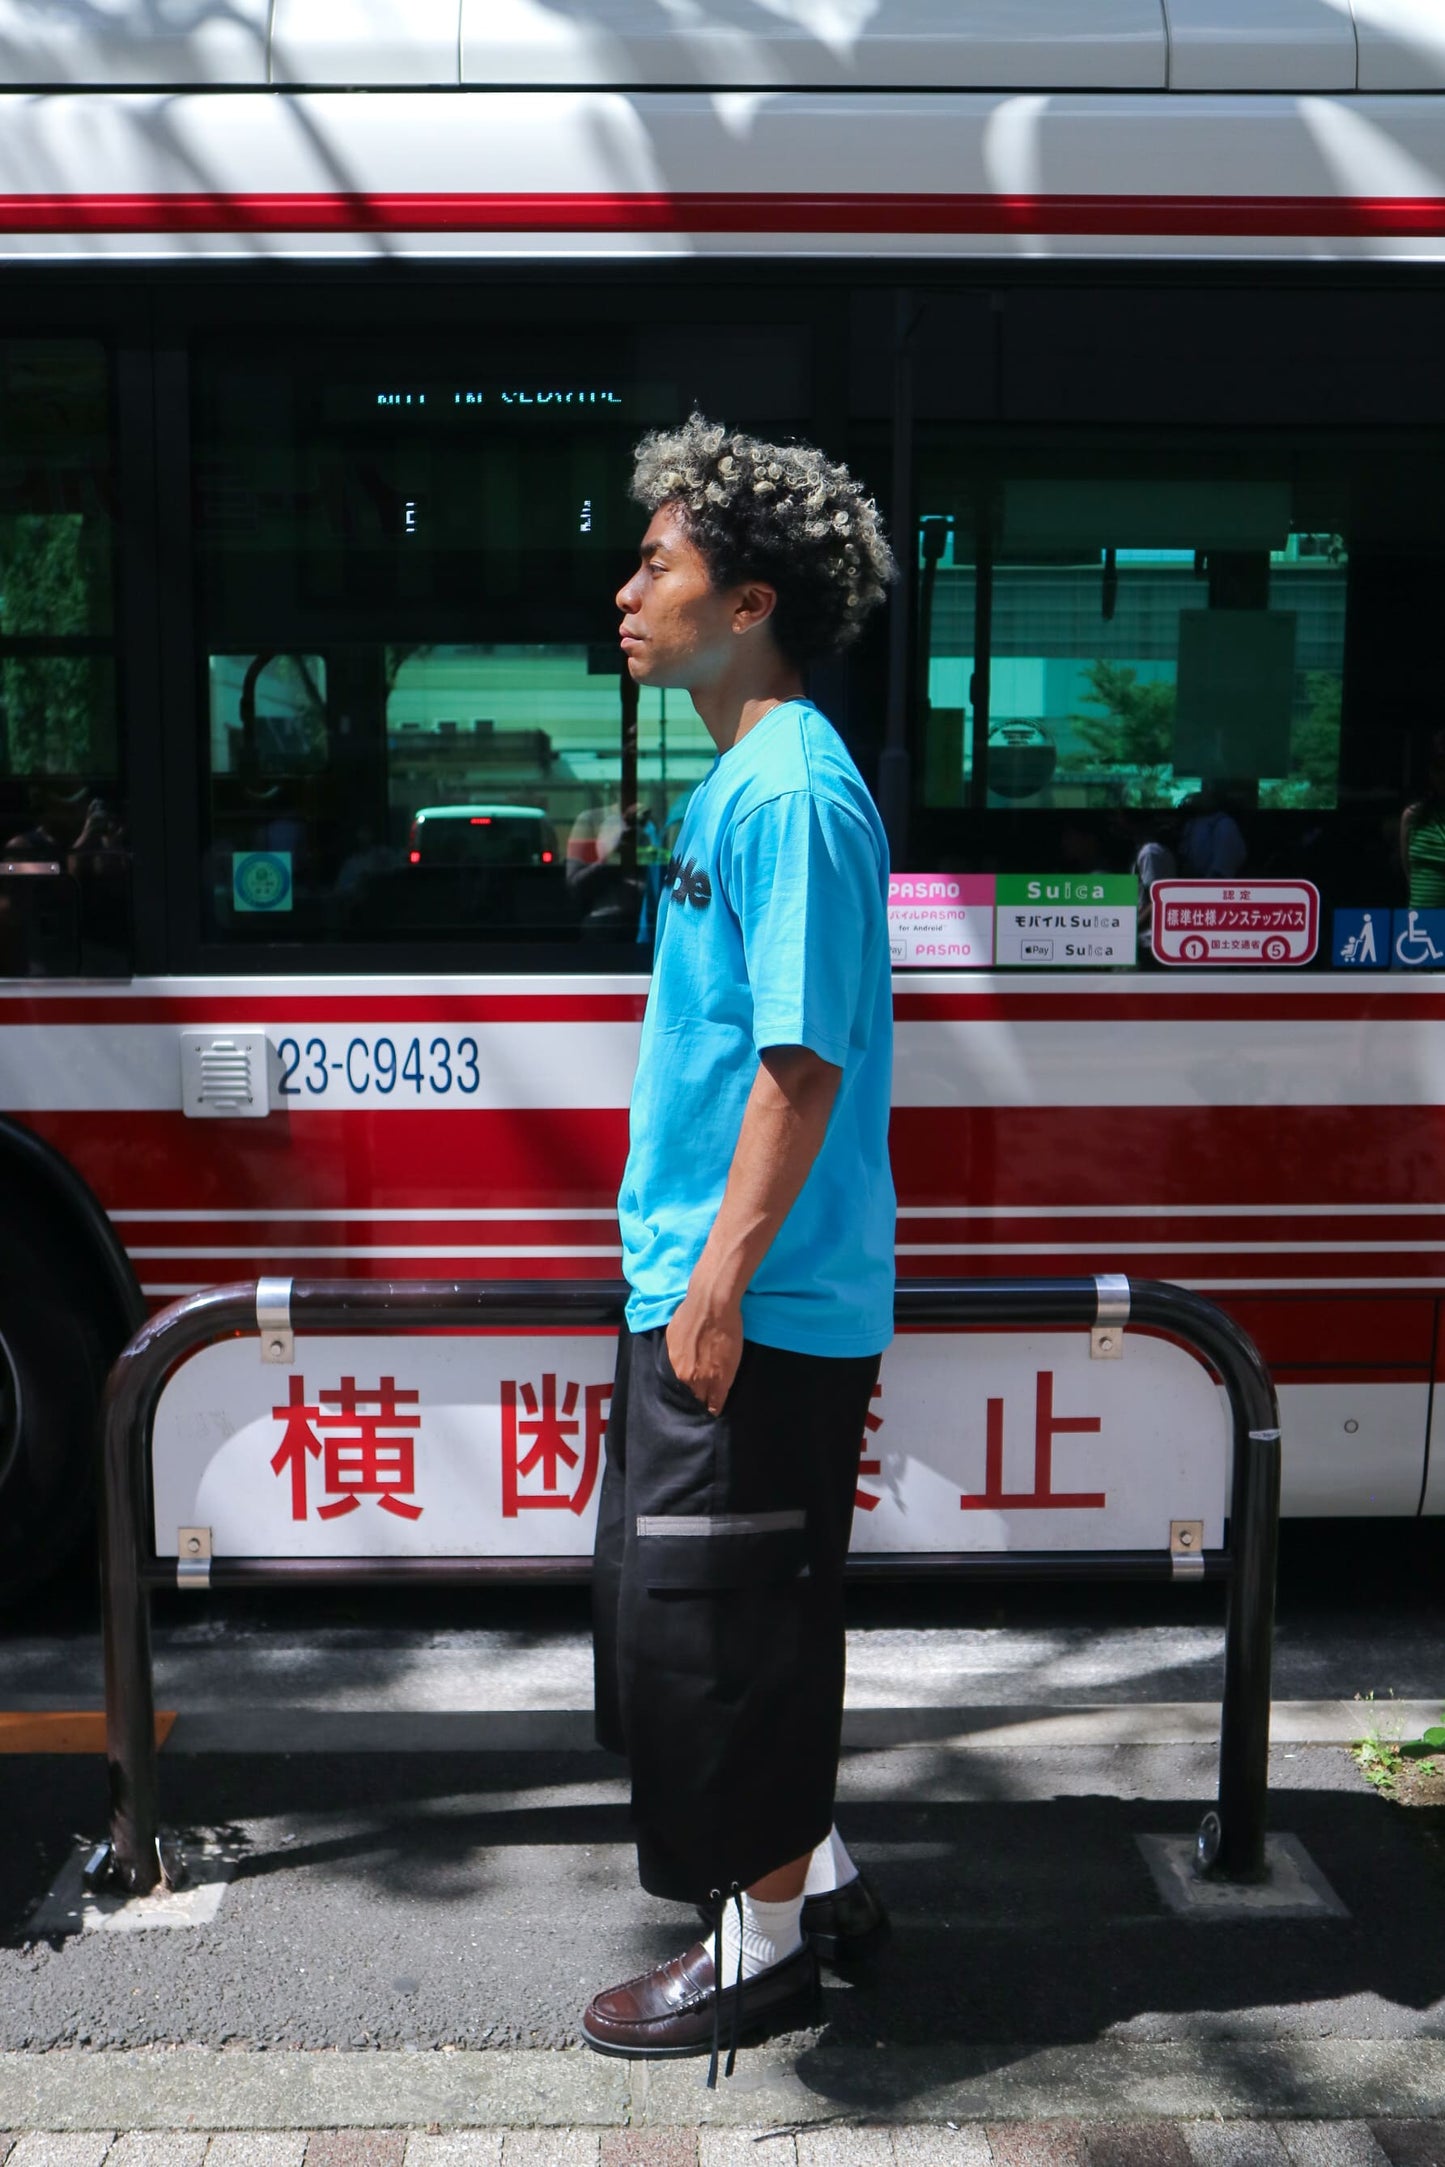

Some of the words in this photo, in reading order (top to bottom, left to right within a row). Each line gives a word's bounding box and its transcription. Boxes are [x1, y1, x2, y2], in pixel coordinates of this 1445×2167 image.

[889, 882, 960, 898] PASMO
[1027, 881, 1105, 899] Suica
[1167, 909, 1305, 927] 標準仕様ノンステップバス
[916, 944, 971, 956] PASMO
[1065, 944, 1114, 956] Suica
[1211, 939, 1260, 950] 国土交通省
[277, 1037, 480, 1095] 23-C9433
[270, 1371, 1106, 1522] 横断止
